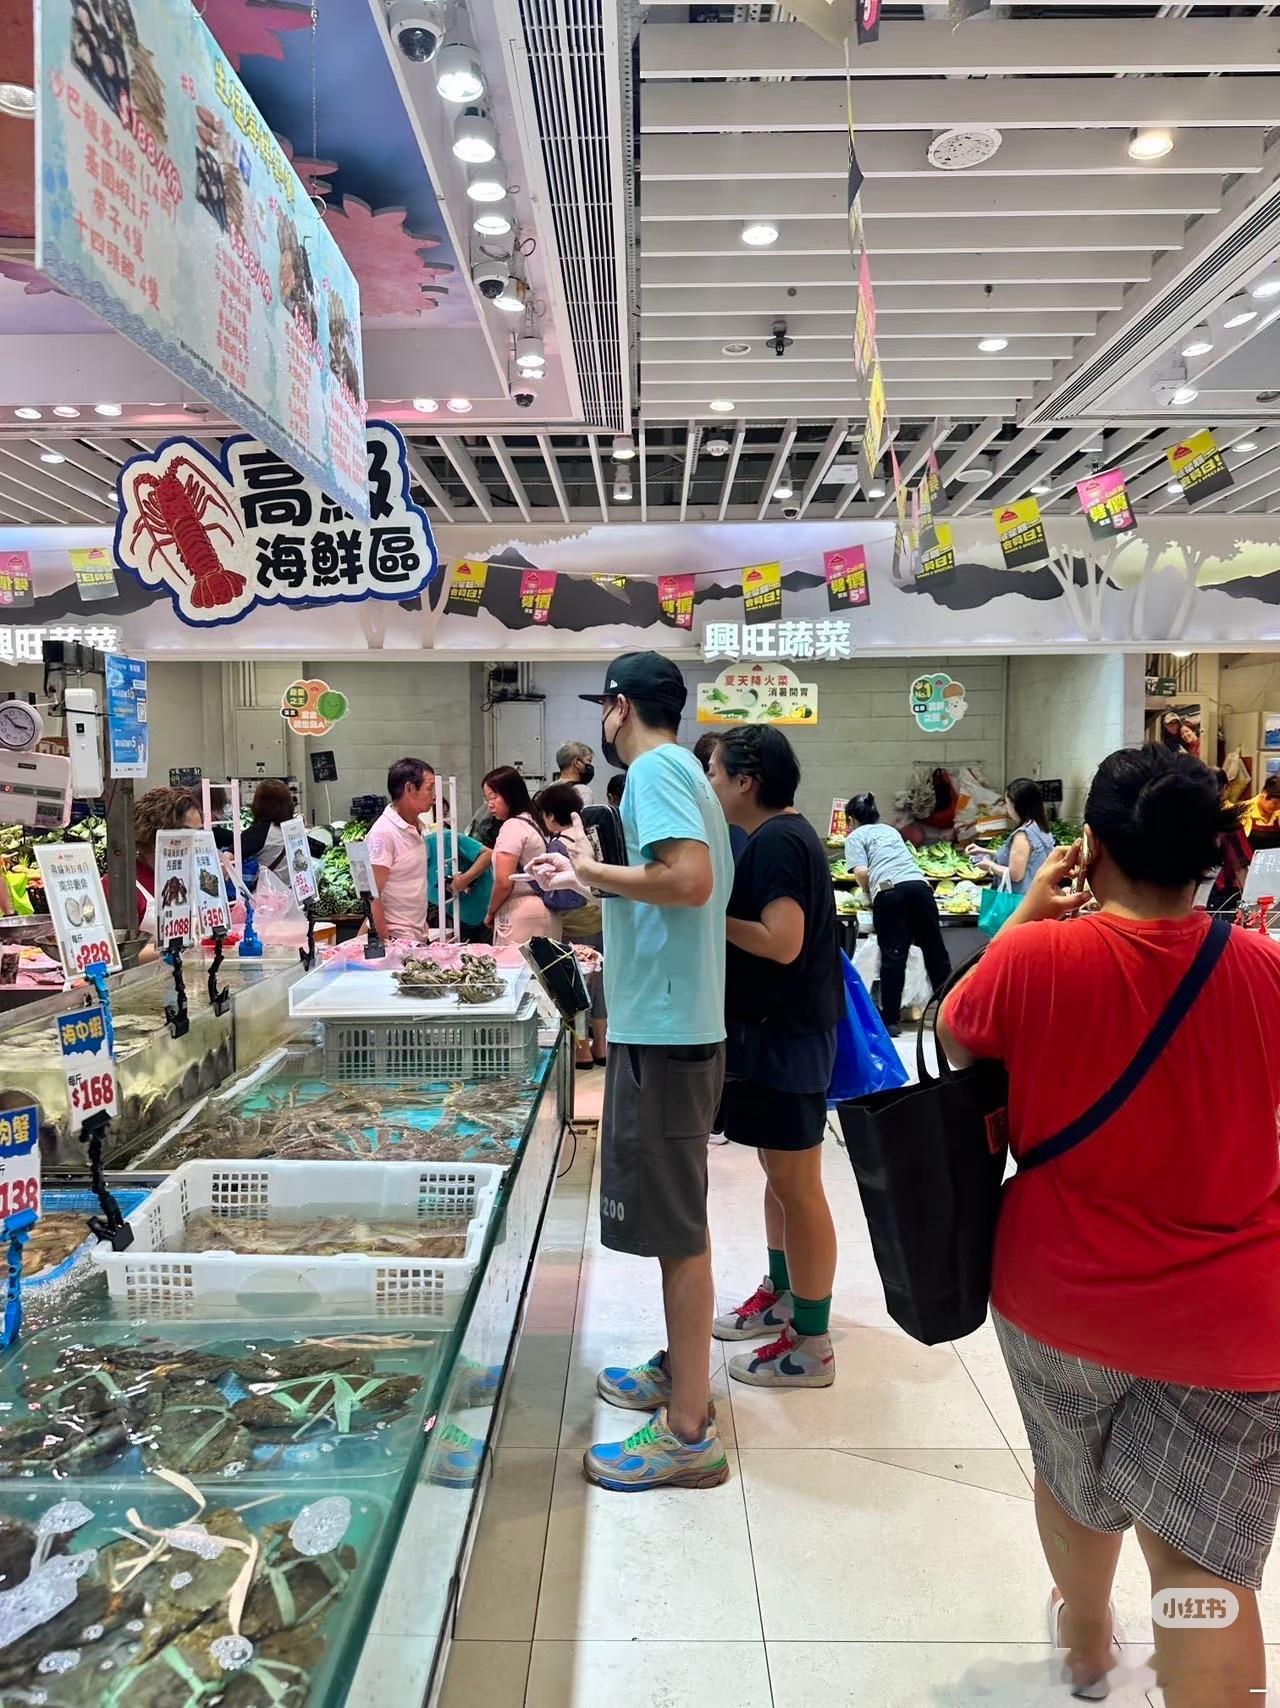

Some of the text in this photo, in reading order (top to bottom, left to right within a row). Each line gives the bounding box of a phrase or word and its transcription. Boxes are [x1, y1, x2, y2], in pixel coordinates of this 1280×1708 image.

[255, 527, 420, 588] 海鮮區
[704, 621, 851, 659] 興旺蔬菜
[725, 675, 788, 687] 夏天降火菜
[768, 688, 808, 698] 消暑開胃
[165, 918, 190, 938] $1088
[203, 908, 224, 929] $350
[77, 941, 111, 971] $228
[61, 1016, 104, 1046] 海中蝦
[68, 1073, 82, 1087] 每斤
[71, 1073, 114, 1111] $168
